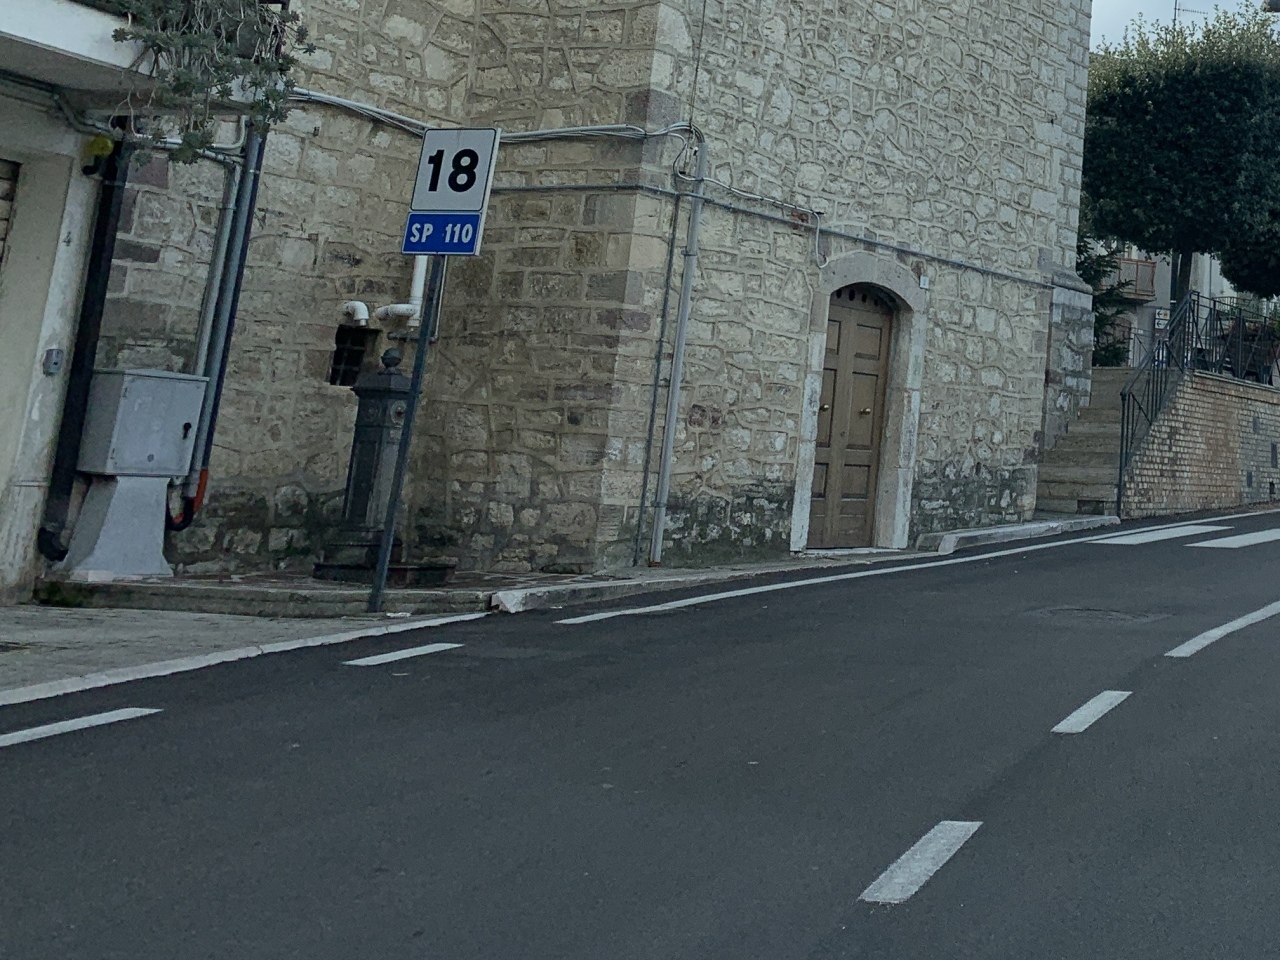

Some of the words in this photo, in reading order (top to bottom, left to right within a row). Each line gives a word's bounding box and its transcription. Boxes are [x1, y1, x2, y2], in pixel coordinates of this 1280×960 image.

[428, 148, 479, 192] 18
[410, 223, 433, 243] SP
[444, 223, 473, 244] 110
